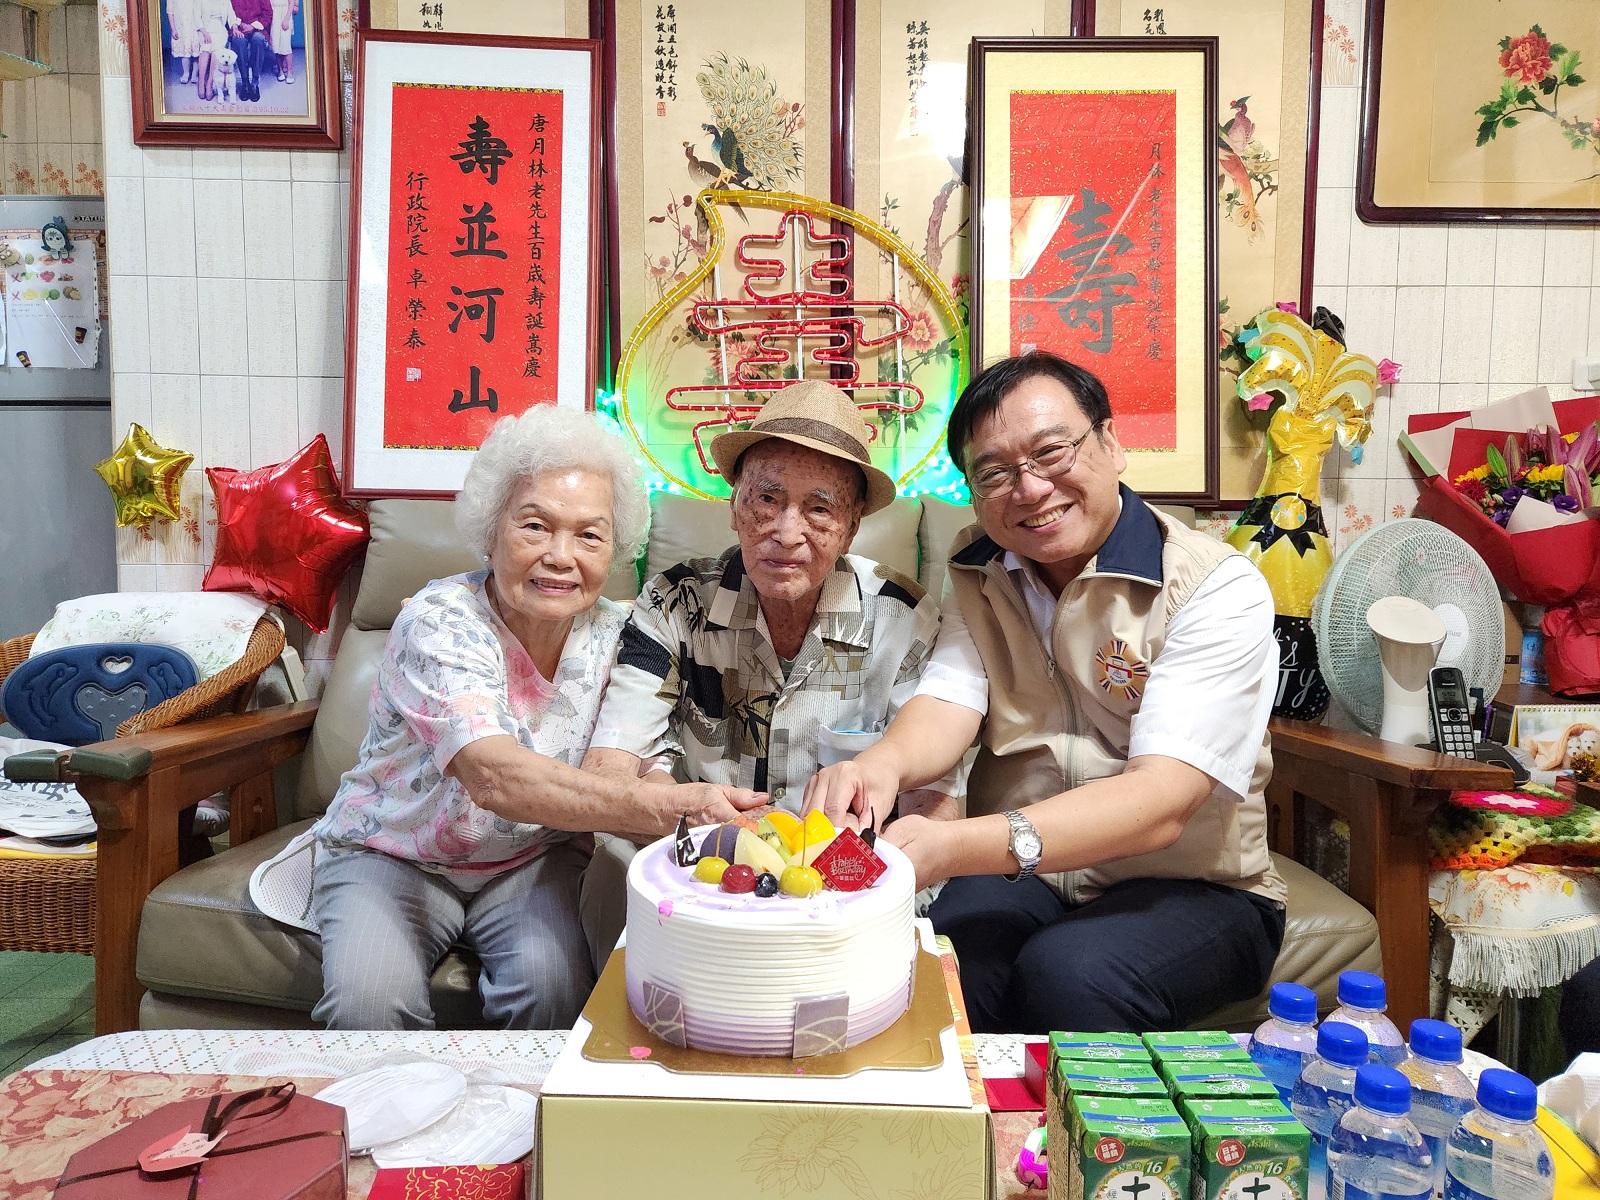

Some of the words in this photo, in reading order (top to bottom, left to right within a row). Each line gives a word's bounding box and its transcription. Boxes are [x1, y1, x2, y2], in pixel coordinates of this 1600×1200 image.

[447, 115, 513, 413] 壽並河山
[1044, 188, 1139, 354] 壽
[1101, 1142, 1117, 1152] 日本
[1222, 1144, 1238, 1155] 日本
[1146, 1161, 1163, 1174] 16
[1266, 1162, 1284, 1175] 16
